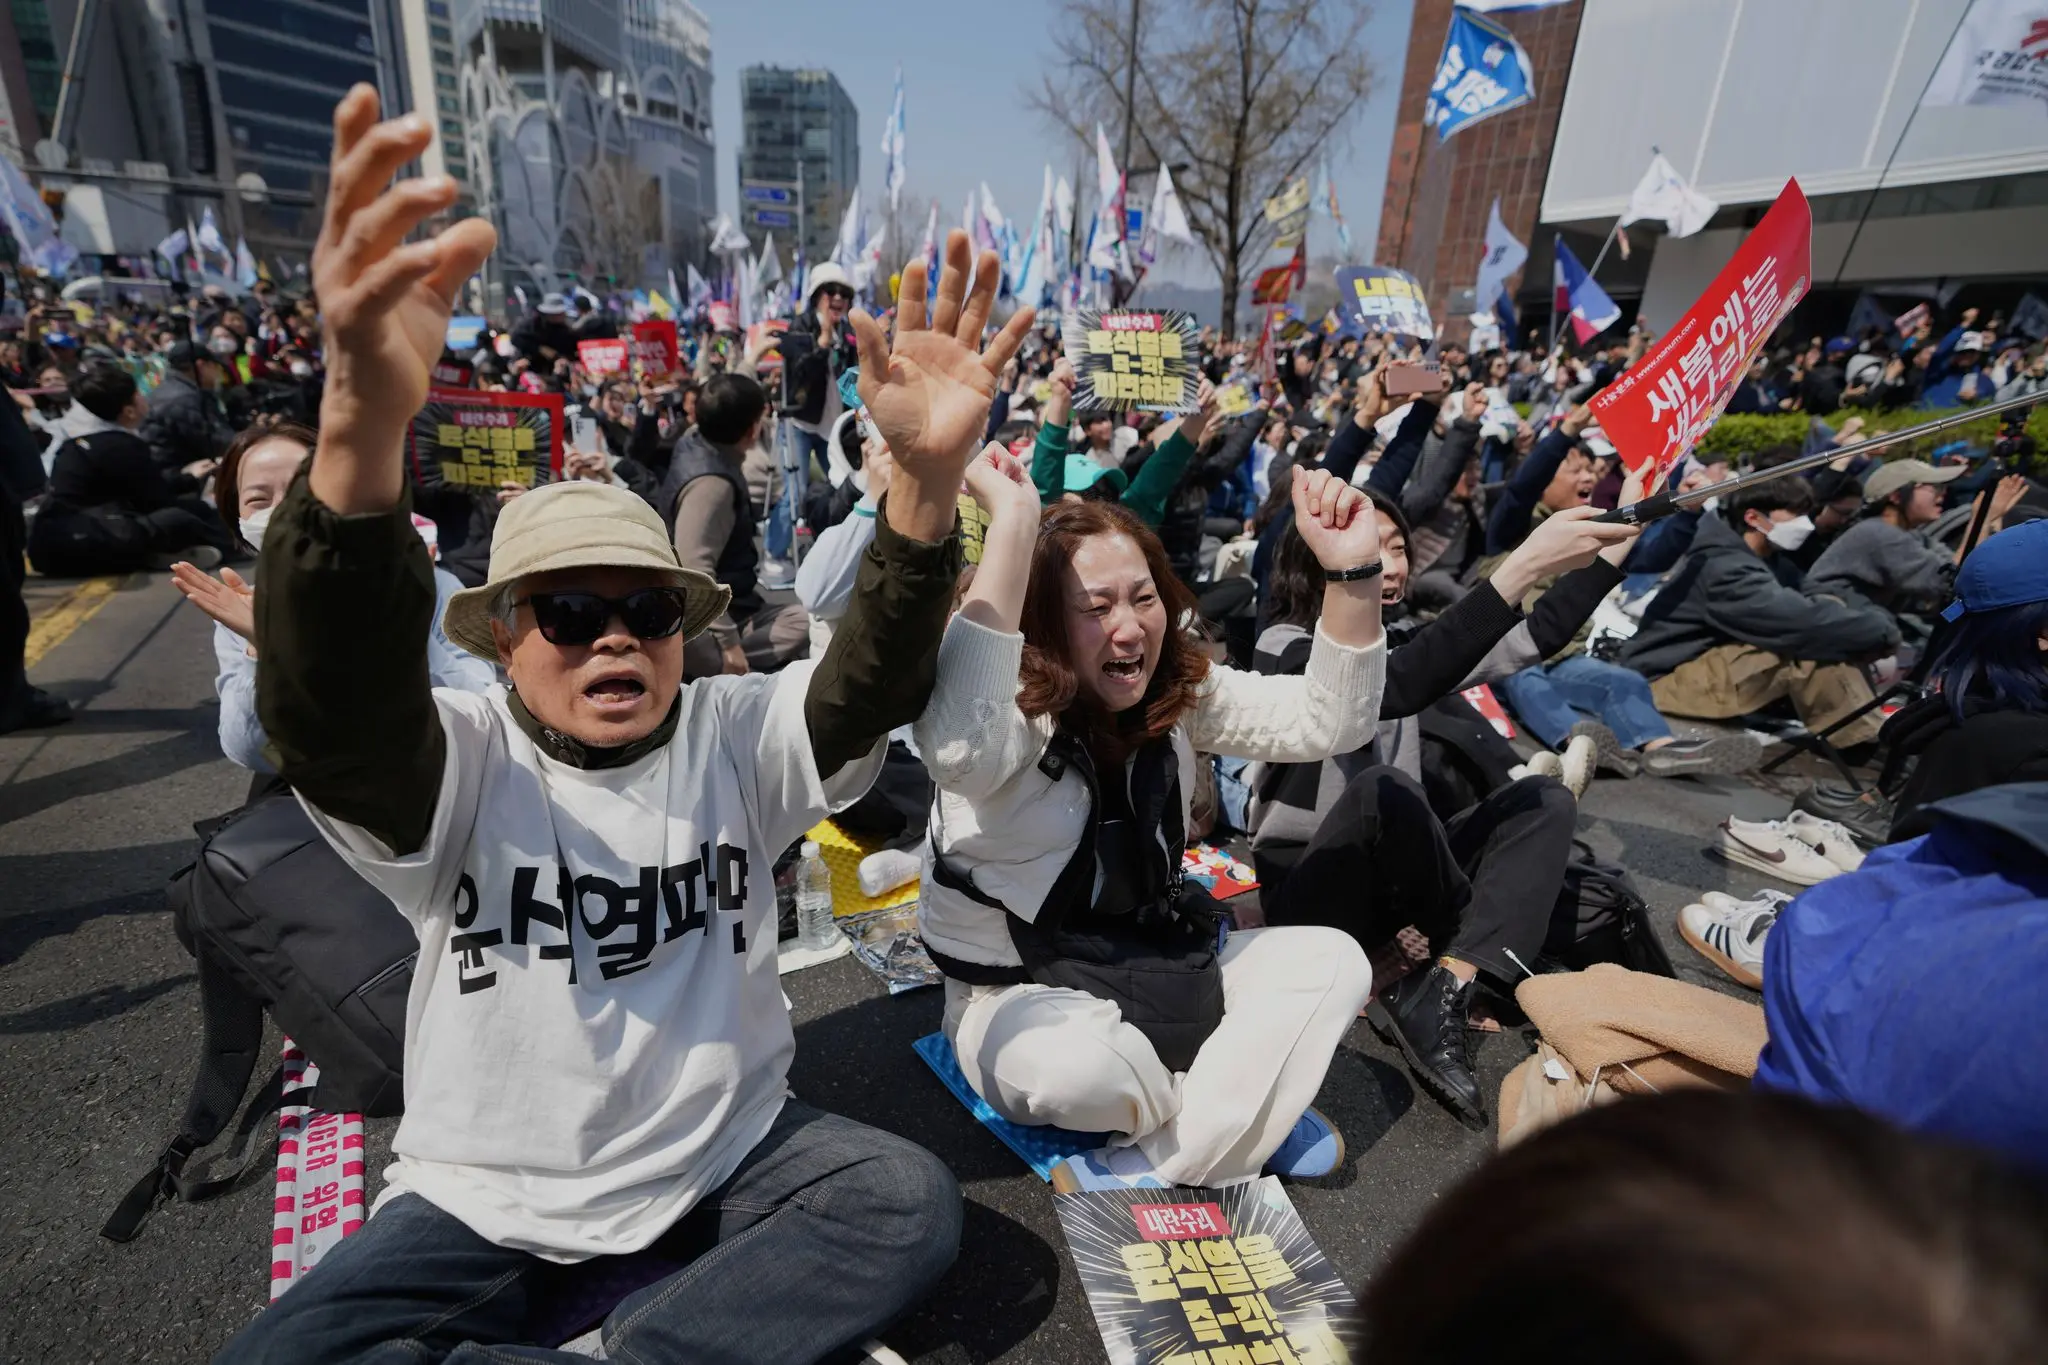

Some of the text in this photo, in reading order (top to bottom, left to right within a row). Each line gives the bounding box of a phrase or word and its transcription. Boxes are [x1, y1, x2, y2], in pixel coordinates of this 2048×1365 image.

[1636, 318, 1697, 380] www.nanum.com
[1646, 256, 1777, 423] 새봄에는
[301, 1181, 339, 1236] 위험
[1121, 1234, 1296, 1303] 윤석열을
